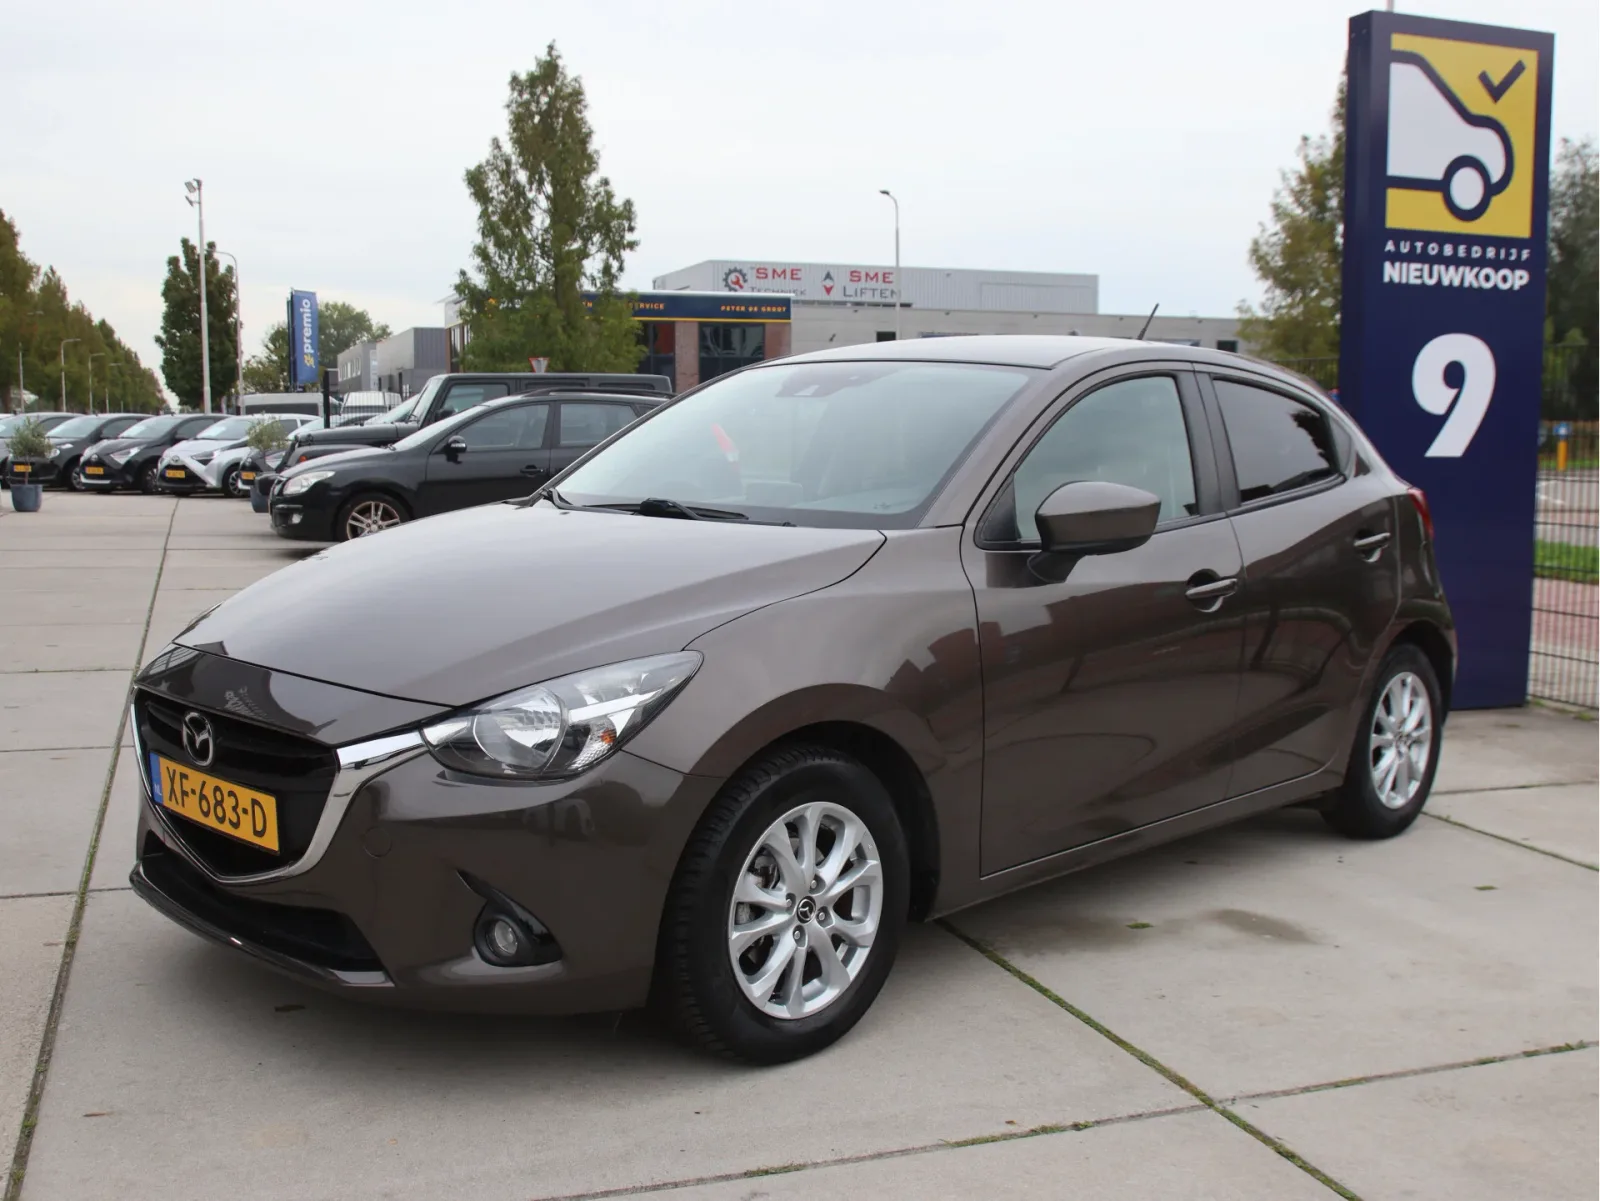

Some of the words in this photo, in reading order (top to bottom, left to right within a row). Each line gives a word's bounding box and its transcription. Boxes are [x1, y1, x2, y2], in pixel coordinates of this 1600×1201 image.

[1384, 240, 1531, 261] AUTOBEDRIJF
[755, 267, 802, 281] SME
[849, 270, 894, 284] SME
[1383, 261, 1530, 291] NIEUWKOOP
[843, 285, 901, 299] LIFTEN
[720, 304, 746, 313] PETER
[300, 298, 315, 354] premio
[1412, 332, 1497, 458] 9
[166, 765, 268, 838] XF-683-D
